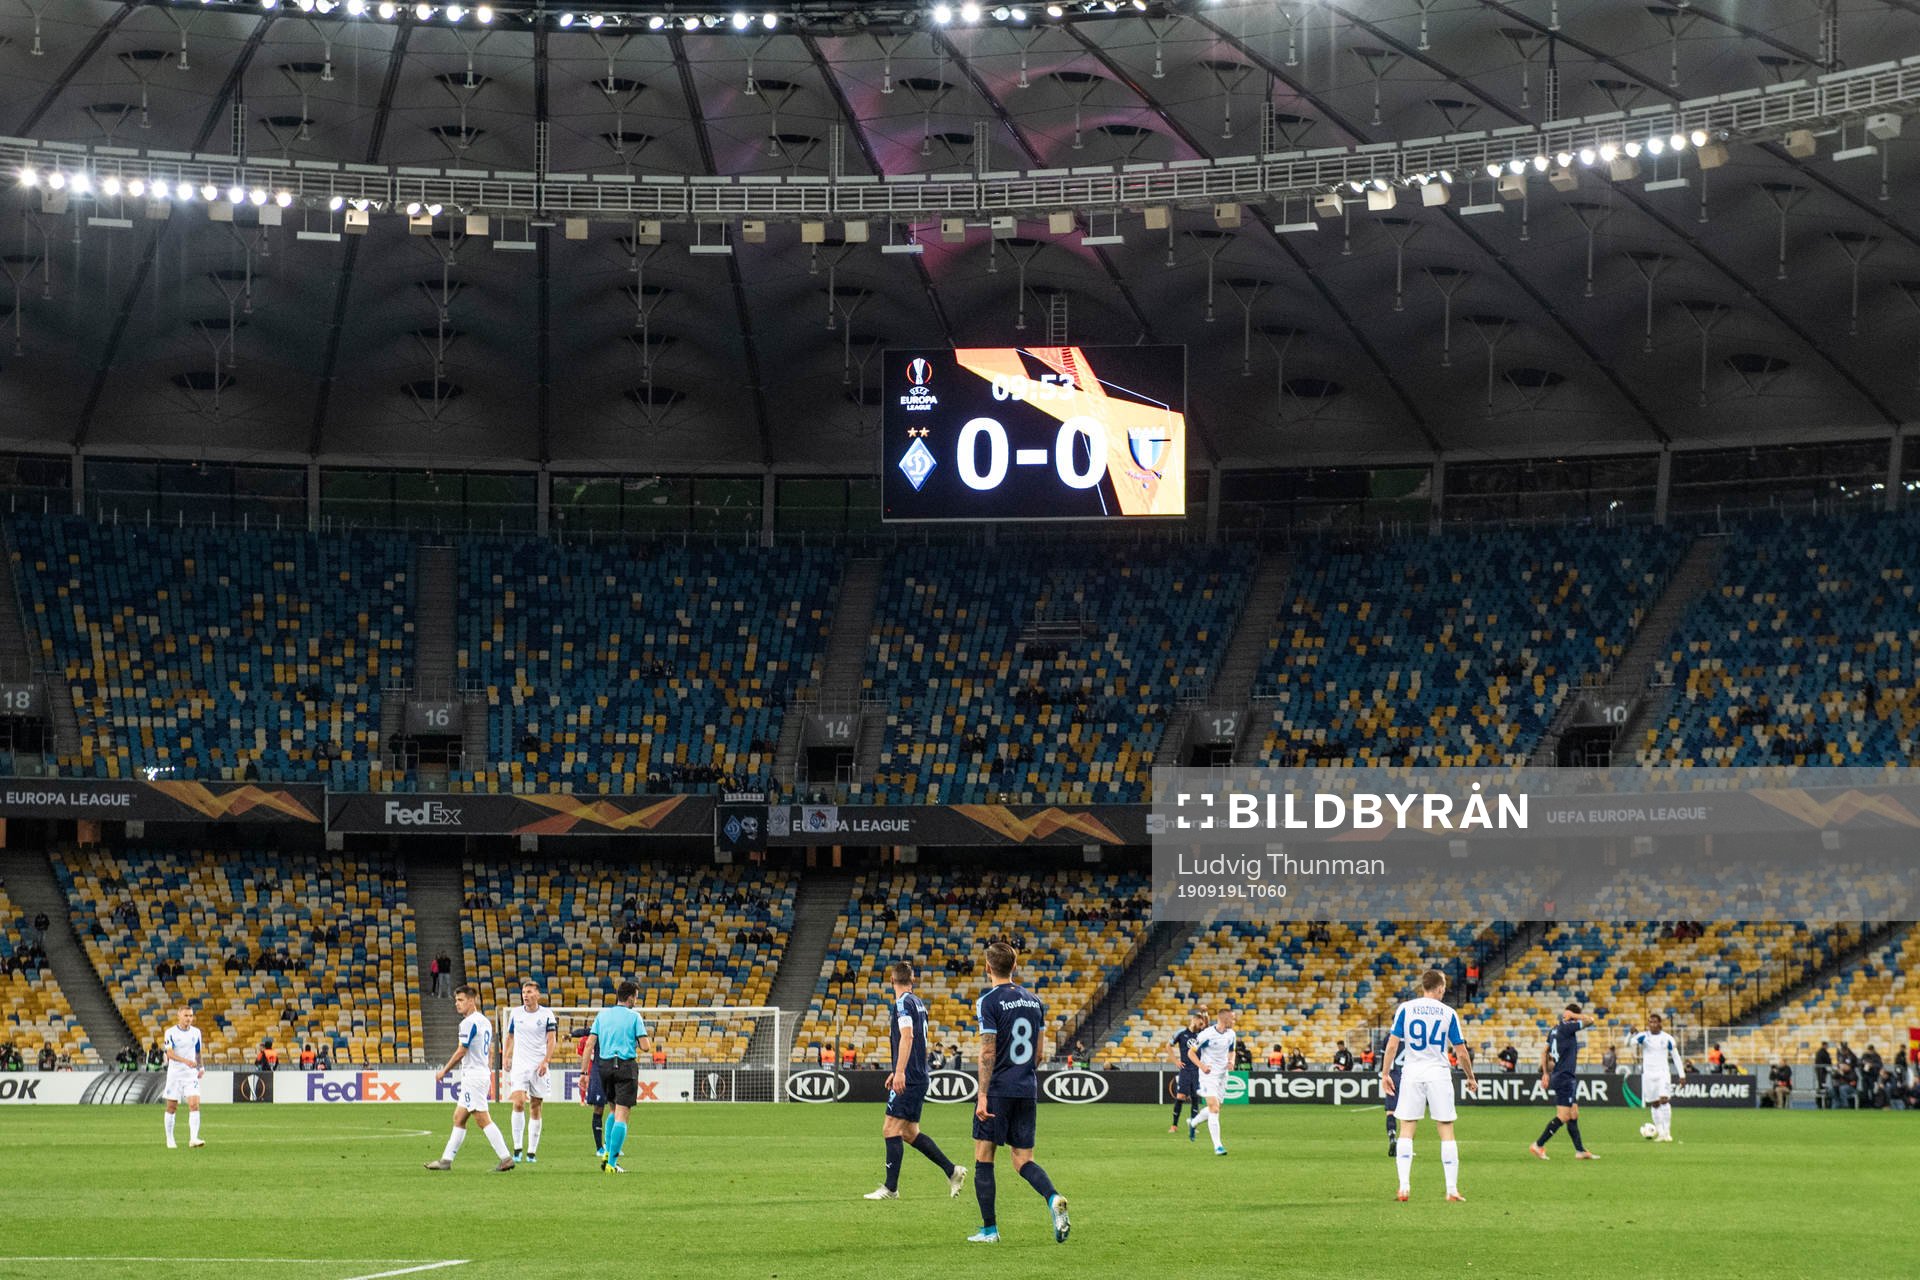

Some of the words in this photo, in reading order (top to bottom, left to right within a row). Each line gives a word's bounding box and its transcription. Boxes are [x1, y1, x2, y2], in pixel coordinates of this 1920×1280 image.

[900, 395, 938, 405] EUROPA
[4, 691, 31, 709] 18
[425, 709, 450, 727] 16
[1602, 706, 1628, 723] 10
[825, 720, 850, 738] 14
[1212, 718, 1235, 736] 12
[6, 791, 67, 805] EUROPA
[70, 793, 130, 806] LEAGUE
[385, 801, 462, 825] FedEx
[1546, 811, 1585, 824] UEFA
[1588, 808, 1646, 823] EUROPA
[1649, 806, 1707, 821] LEAGUE
[853, 819, 910, 832] LEAGUE
[483, 1030, 491, 1056] 8
[1010, 1017, 1033, 1065] 8
[1409, 1019, 1446, 1052] 94
[307, 1072, 401, 1101] FedEx
[796, 1077, 835, 1096] KIA
[926, 1077, 968, 1096] KIA
[1055, 1077, 1098, 1097] KIA
[1223, 1073, 1388, 1105] enterpri
[1460, 1079, 1609, 1101] RENT-A-AR
